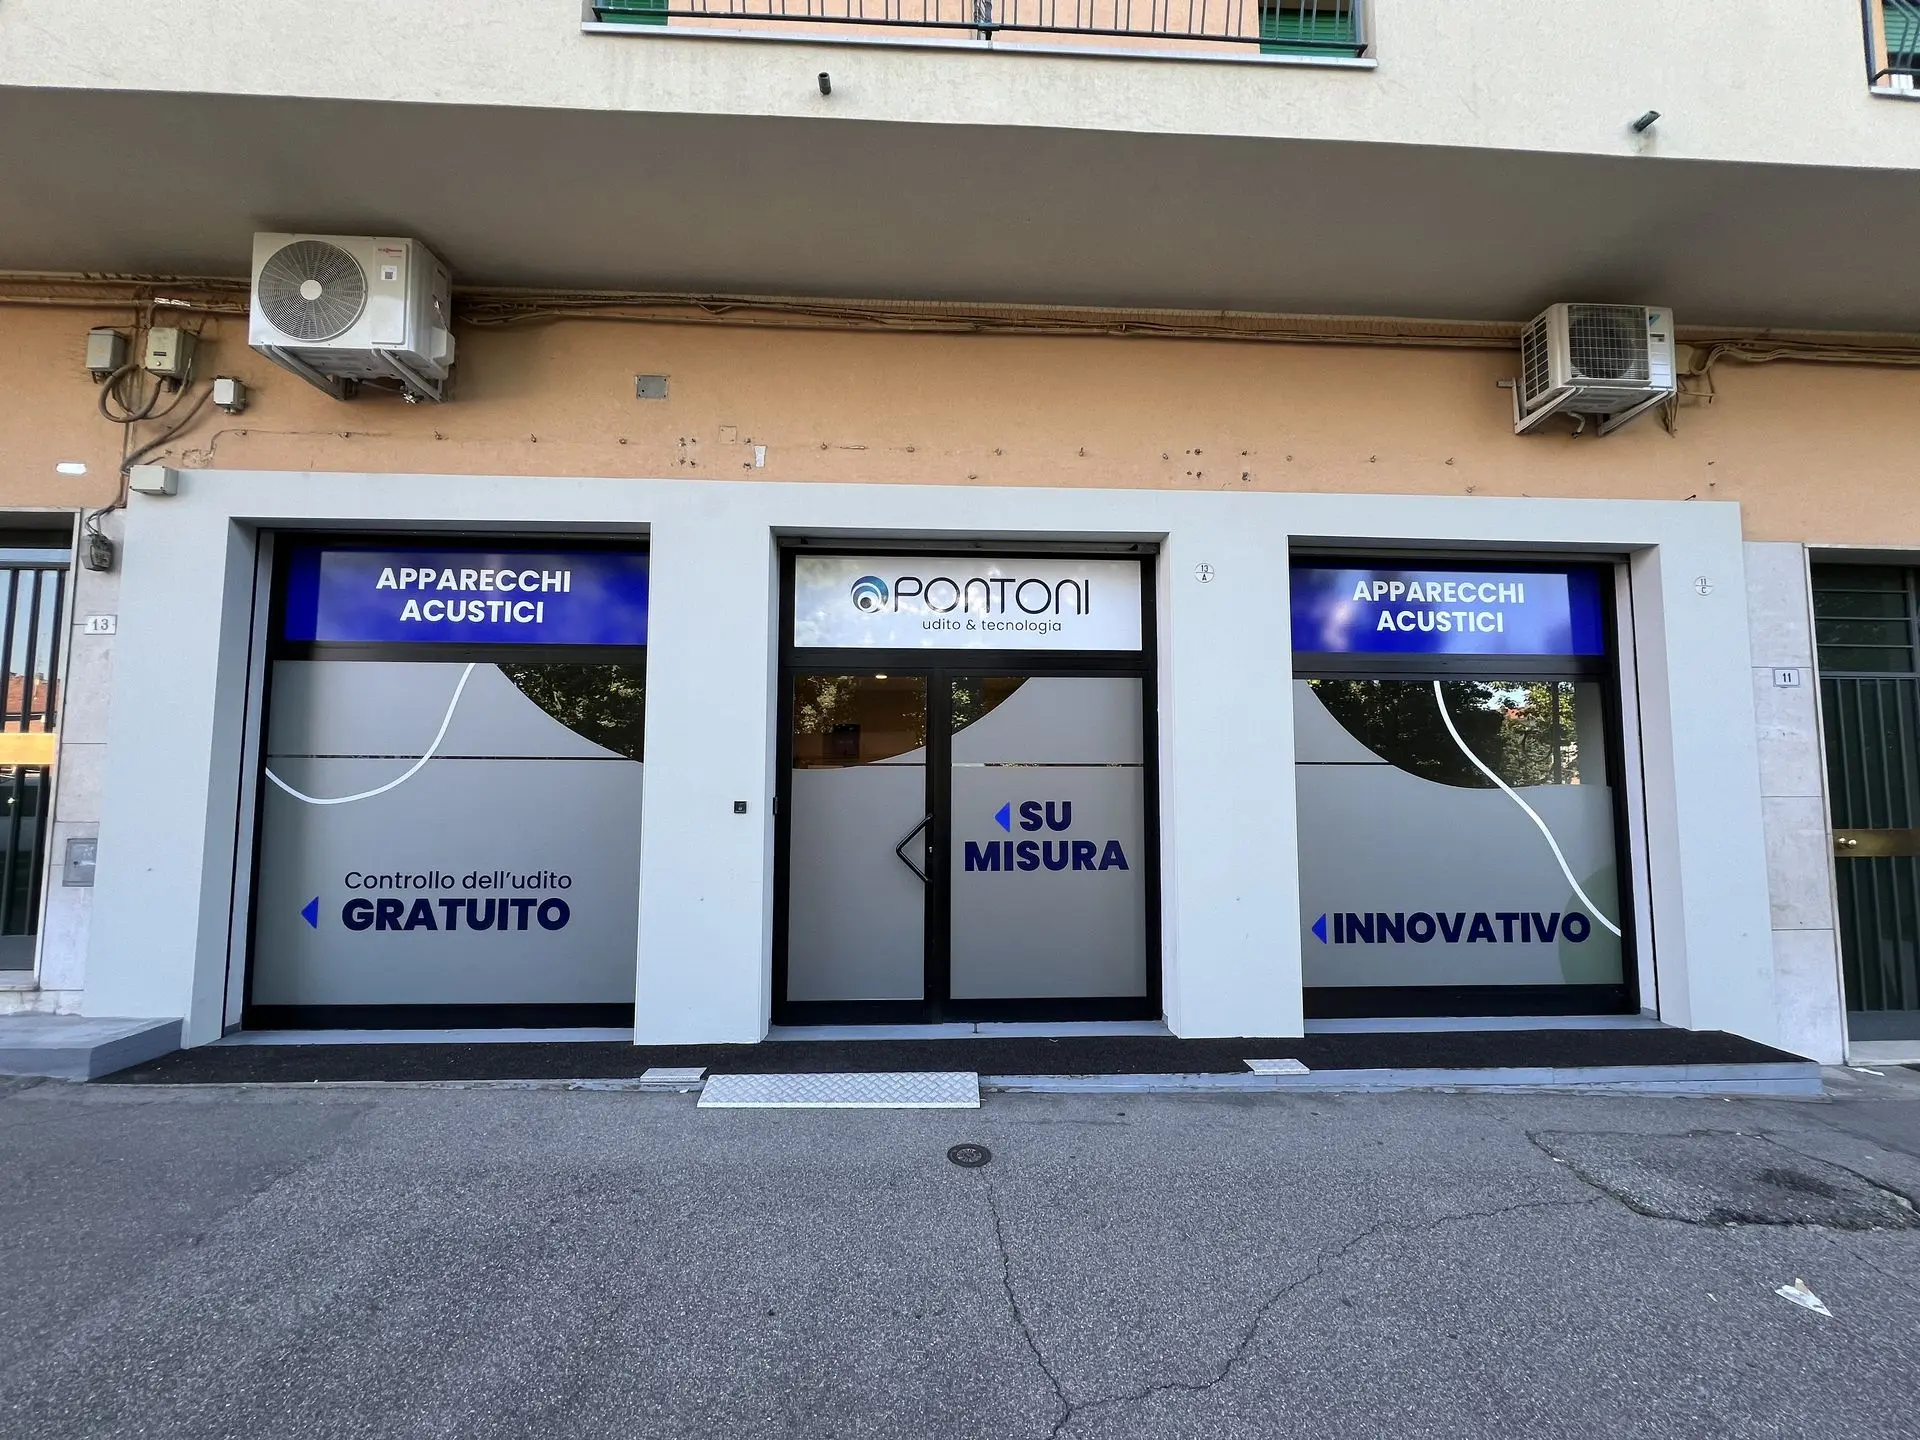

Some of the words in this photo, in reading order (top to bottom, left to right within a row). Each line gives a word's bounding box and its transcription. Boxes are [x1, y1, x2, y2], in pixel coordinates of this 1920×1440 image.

[375, 567, 571, 593] APPARECCHI
[1201, 573, 1208, 581] A
[893, 576, 1090, 616] PONTONI
[1352, 580, 1525, 604] APPARECCHI
[1701, 586, 1707, 594] C
[399, 599, 544, 624] ACUSTICI
[1376, 610, 1504, 633] ACUSTICI
[92, 618, 109, 631] 13
[922, 618, 962, 631] udito
[966, 618, 977, 631] &
[981, 618, 1063, 635] tecnologia
[1782, 672, 1792, 683] 11
[1019, 800, 1072, 832] SU
[964, 840, 1130, 872] MISURA
[344, 870, 456, 890] Controllo
[461, 870, 573, 890] dell'udito
[341, 897, 571, 931] GRATUITO
[1333, 911, 1592, 944] INNOVATIVO
